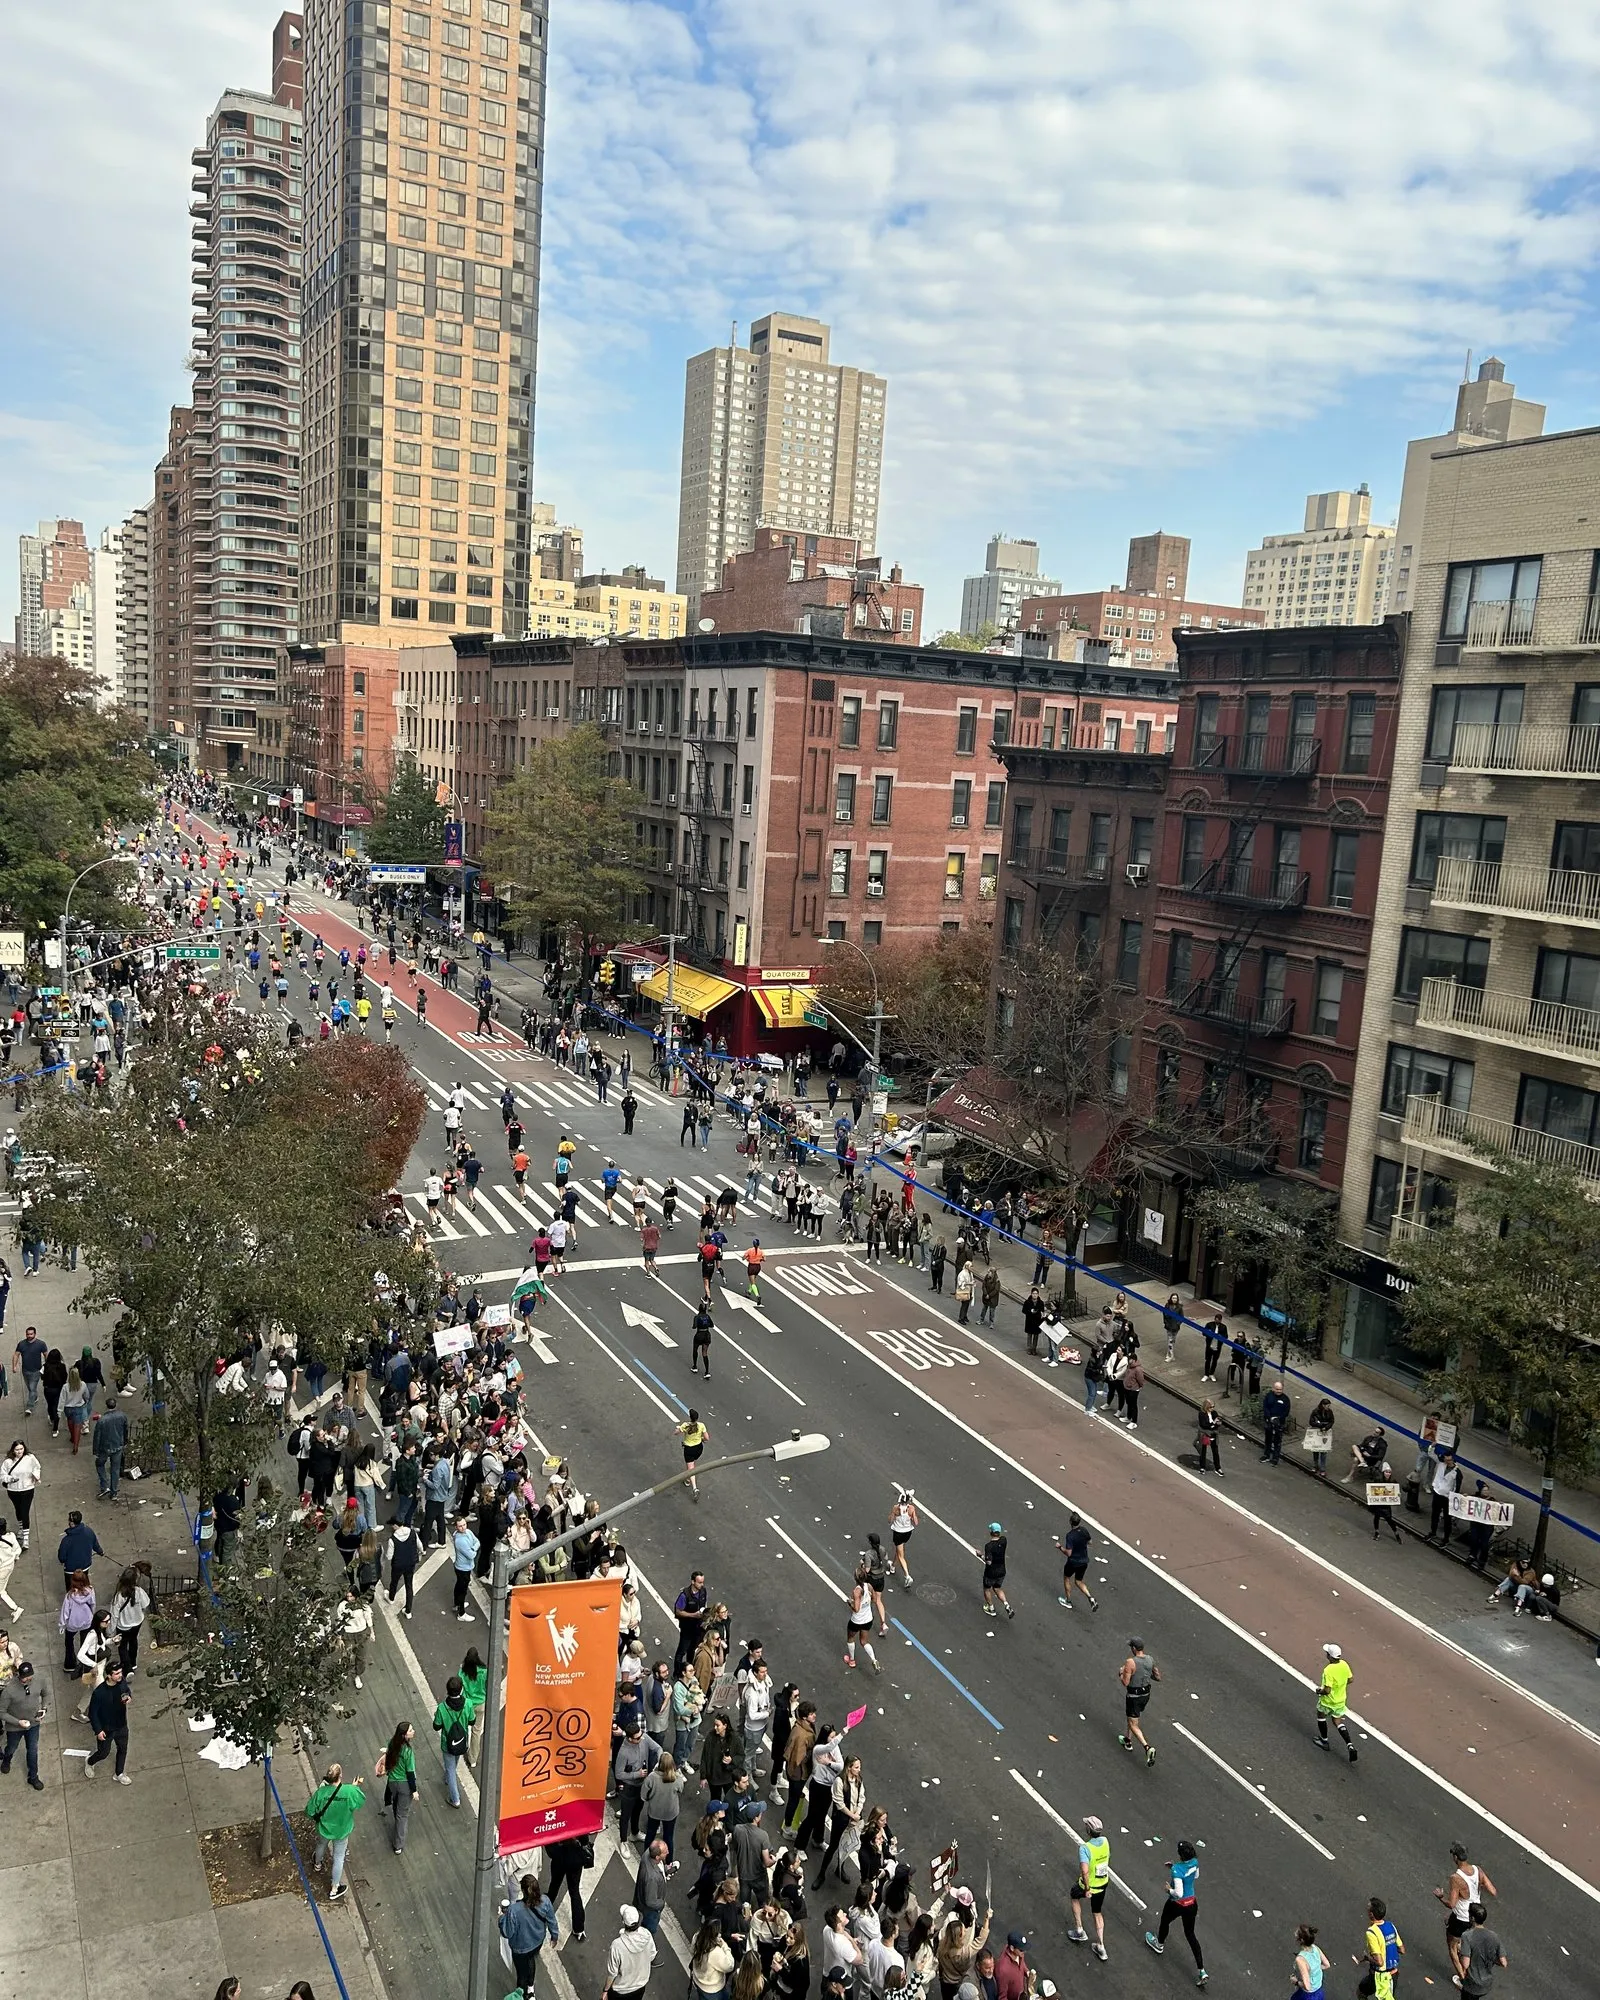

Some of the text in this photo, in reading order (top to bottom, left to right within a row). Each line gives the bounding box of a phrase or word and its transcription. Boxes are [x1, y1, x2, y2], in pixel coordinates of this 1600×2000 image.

[176, 949, 210, 957] E 82 St
[456, 1031, 513, 1044] ONLY
[478, 1048, 544, 1062] BUS
[775, 1262, 875, 1297] ONLY
[866, 1328, 980, 1371] BUS
[536, 1663, 552, 1673] tcs
[552, 1672, 570, 1680] YORK
[570, 1671, 586, 1679] CITY
[523, 1708, 591, 1746] 20
[522, 1745, 587, 1787] 23
[557, 1783, 572, 1791] MOVE
[533, 1820, 566, 1834] Citizens
